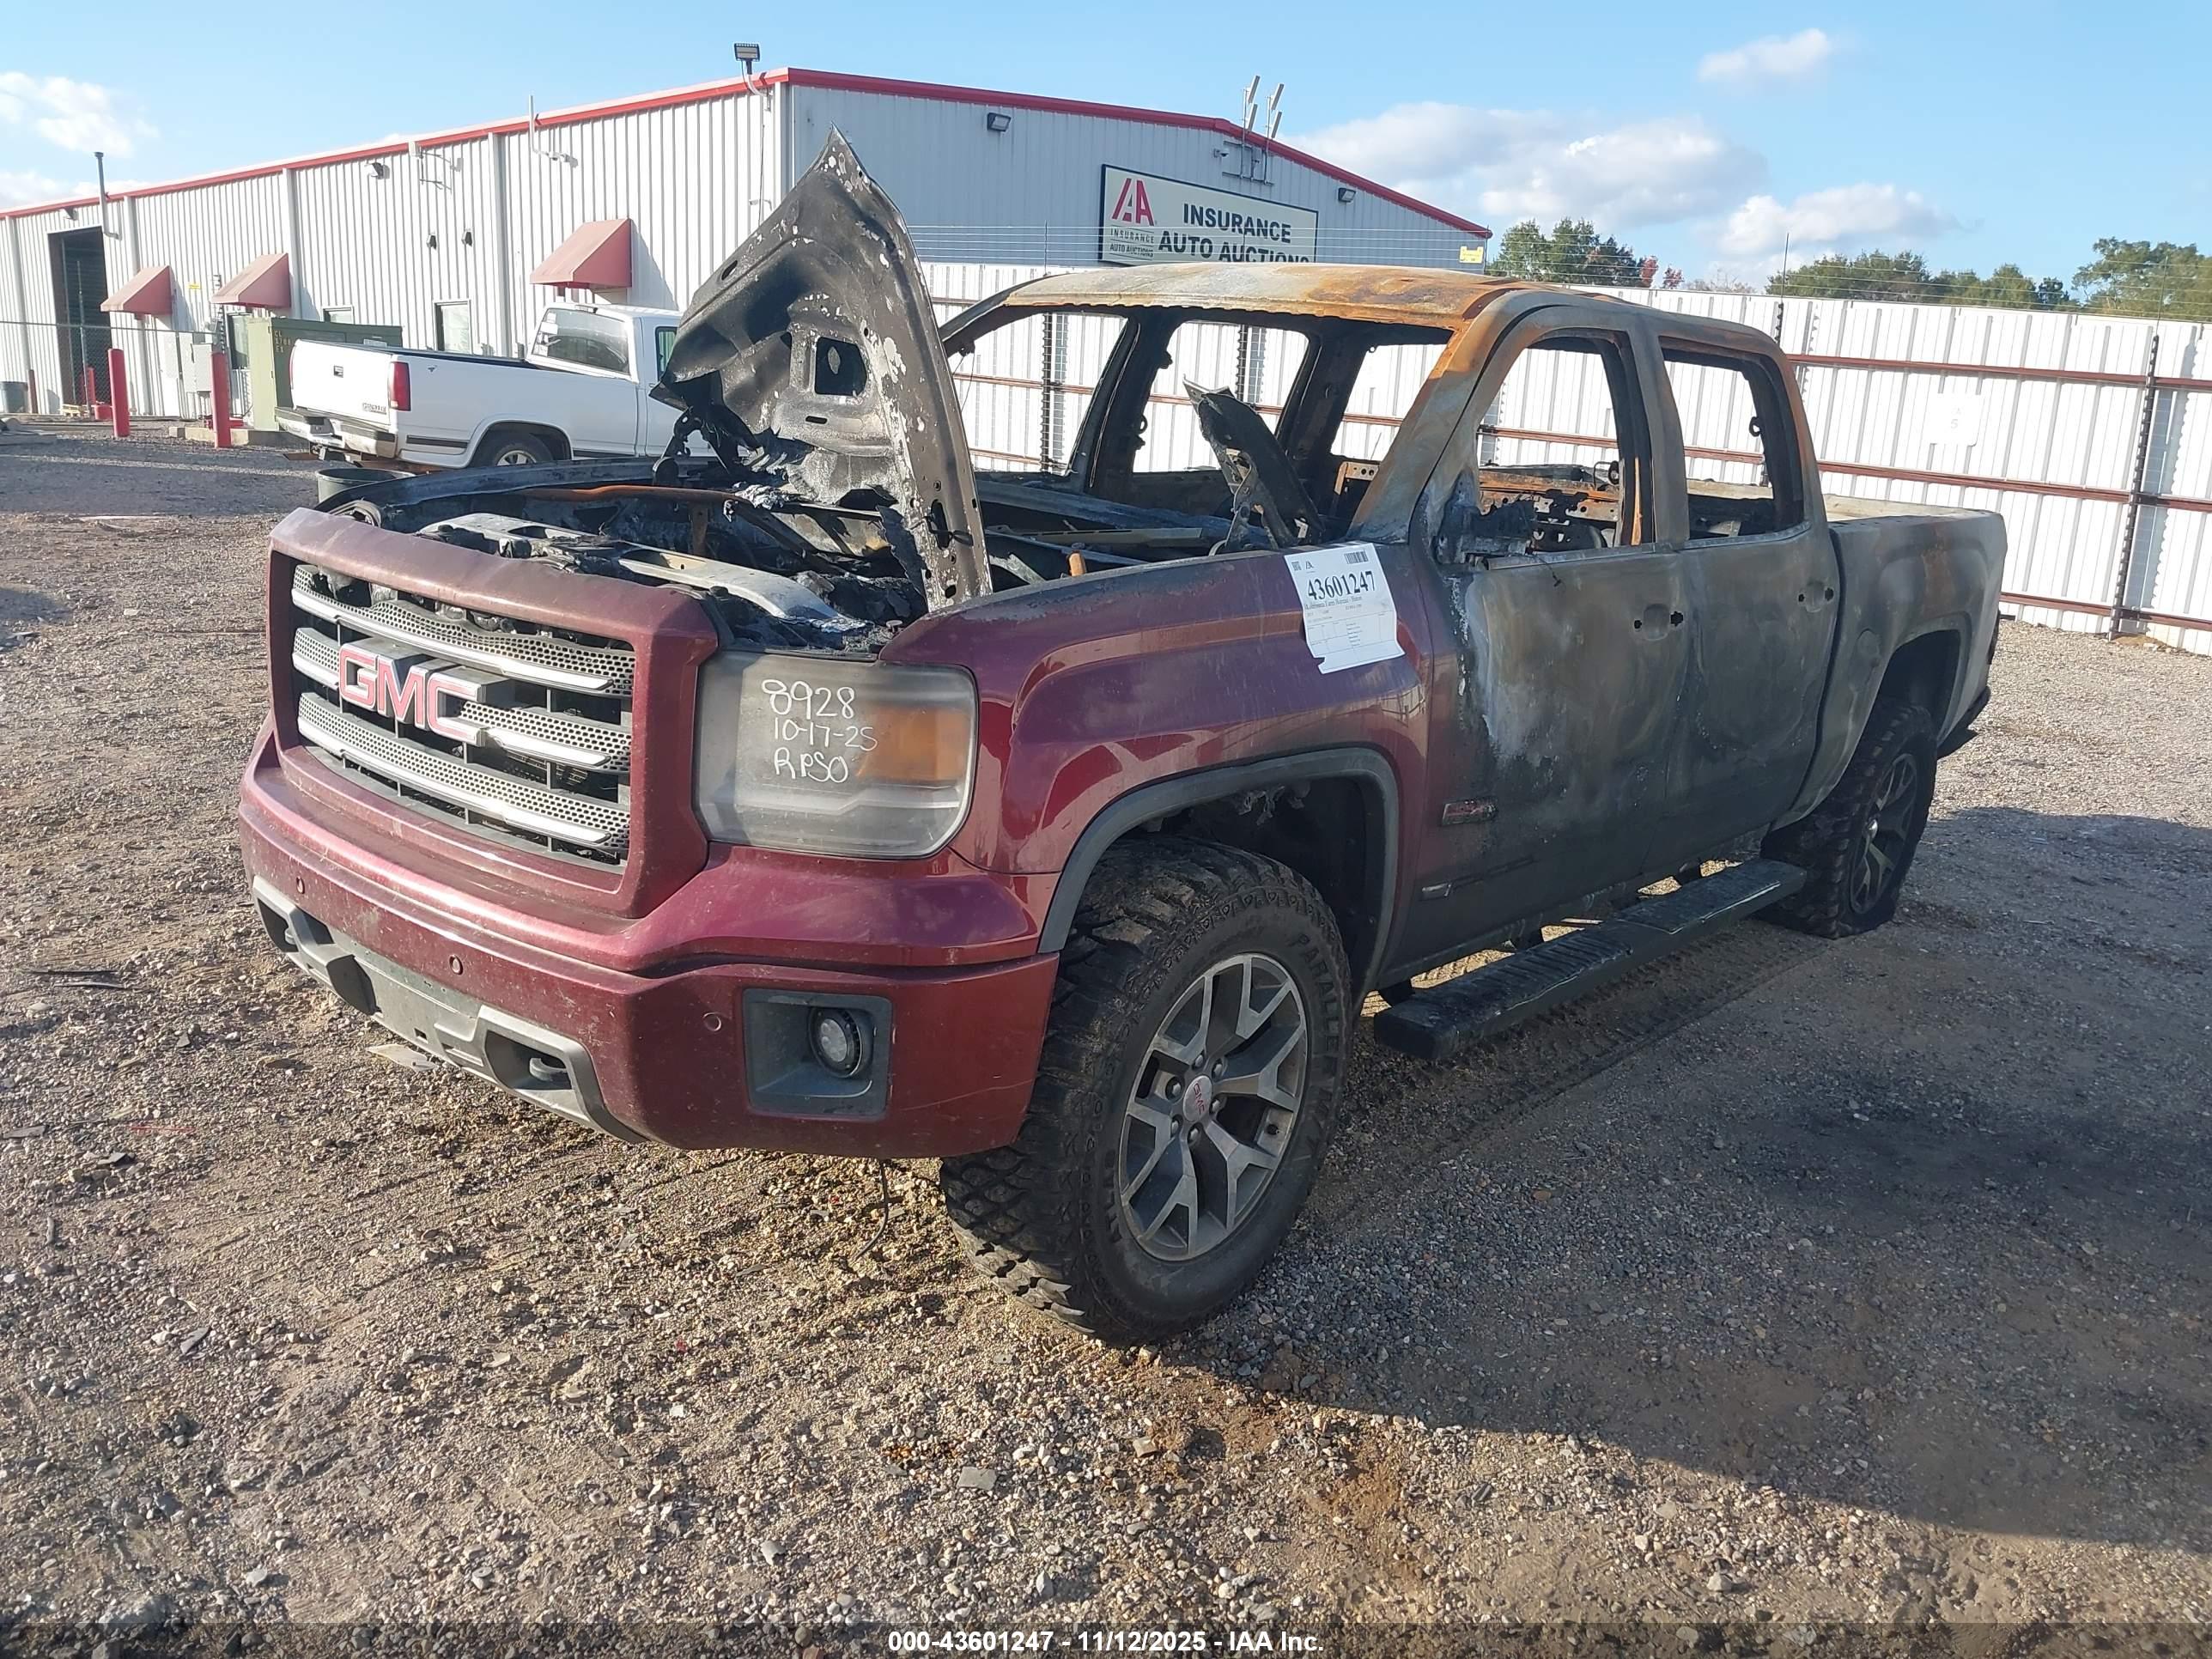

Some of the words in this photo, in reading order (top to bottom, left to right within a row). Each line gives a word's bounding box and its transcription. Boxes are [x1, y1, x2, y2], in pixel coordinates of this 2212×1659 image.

[1110, 228, 1155, 244] INSURANCE
[1183, 204, 1291, 243] INSURANCE
[1158, 231, 1214, 258] AUTO
[1308, 571, 1376, 600] 43601247
[339, 643, 482, 746] GMC
[762, 679, 855, 720] 8928
[1193, 1082, 1205, 1116] GMC
